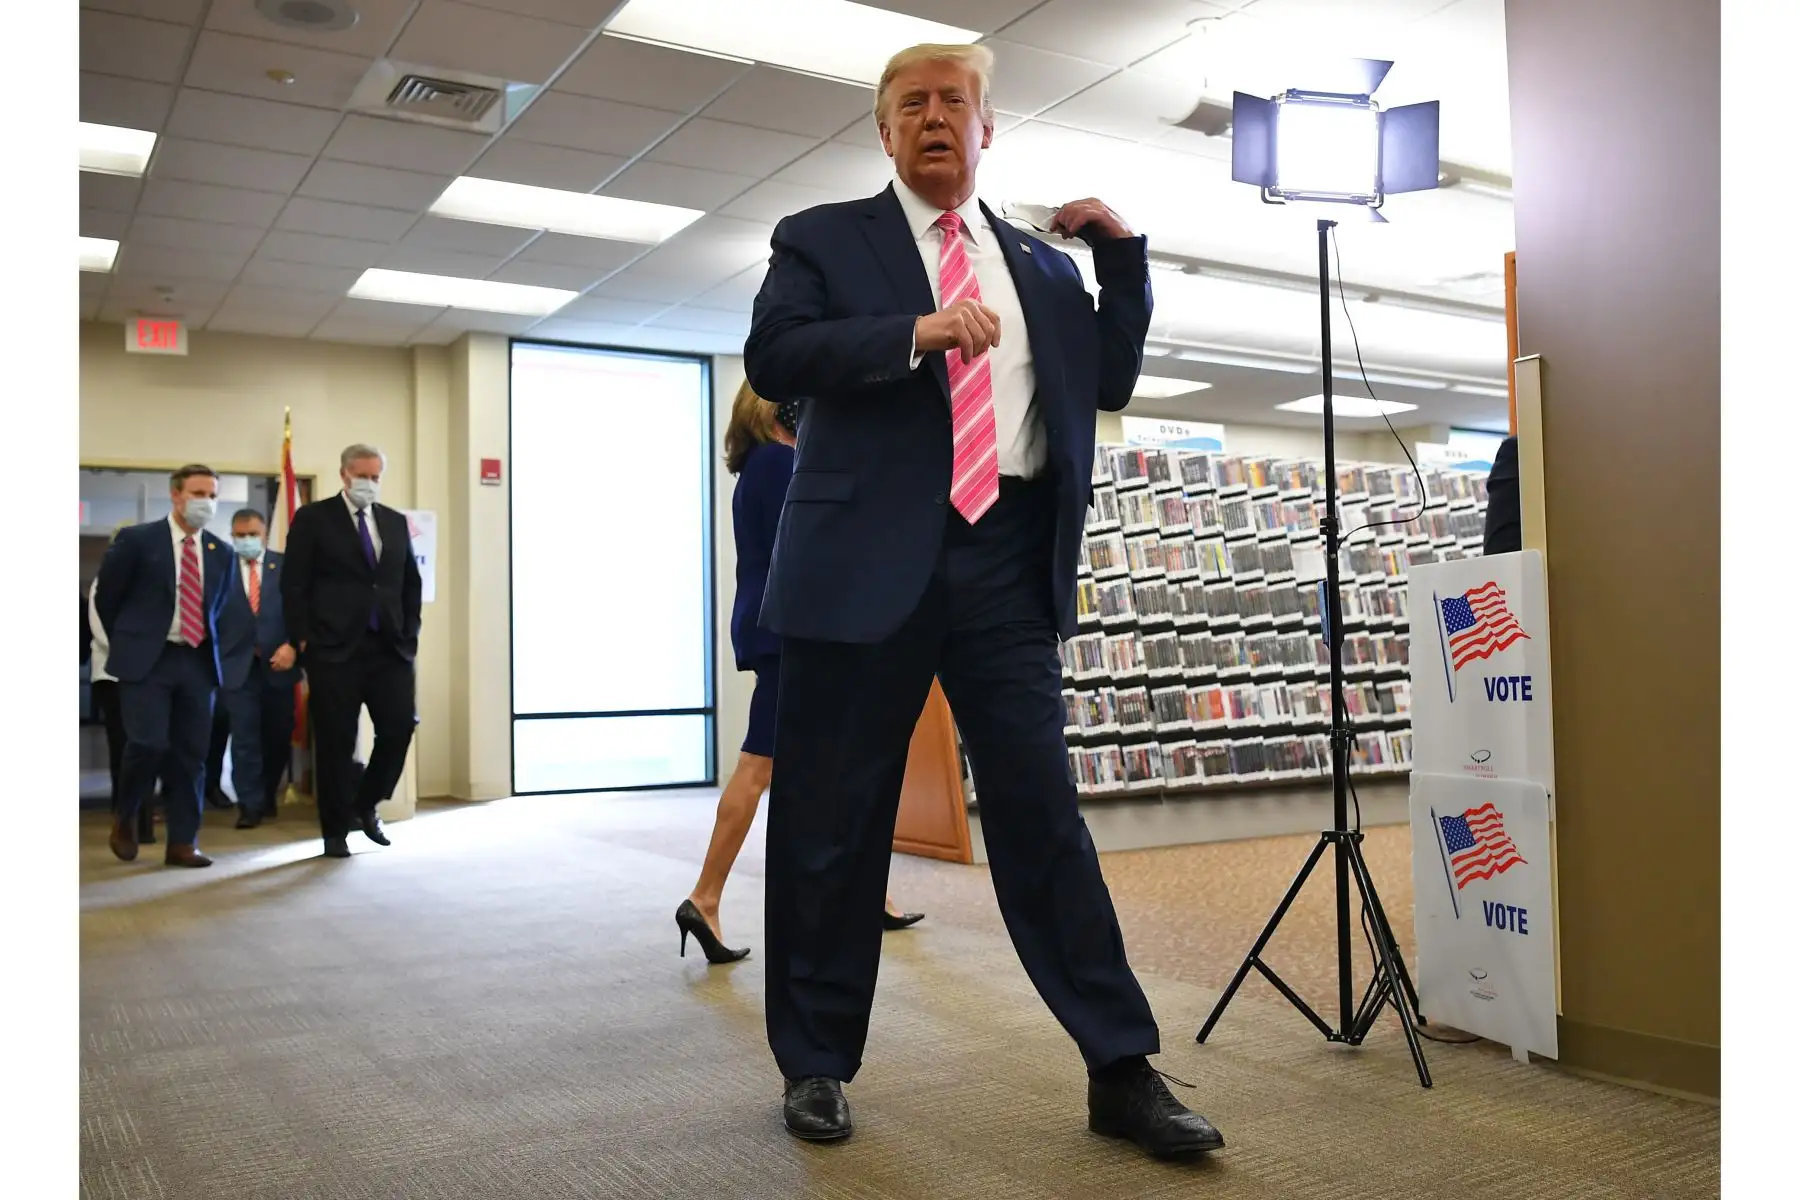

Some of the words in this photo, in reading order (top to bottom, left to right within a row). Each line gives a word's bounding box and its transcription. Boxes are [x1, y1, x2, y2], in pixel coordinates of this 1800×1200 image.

[137, 319, 177, 350] EXIT
[1483, 675, 1533, 702] VOTE
[1482, 900, 1529, 935] VOTE
